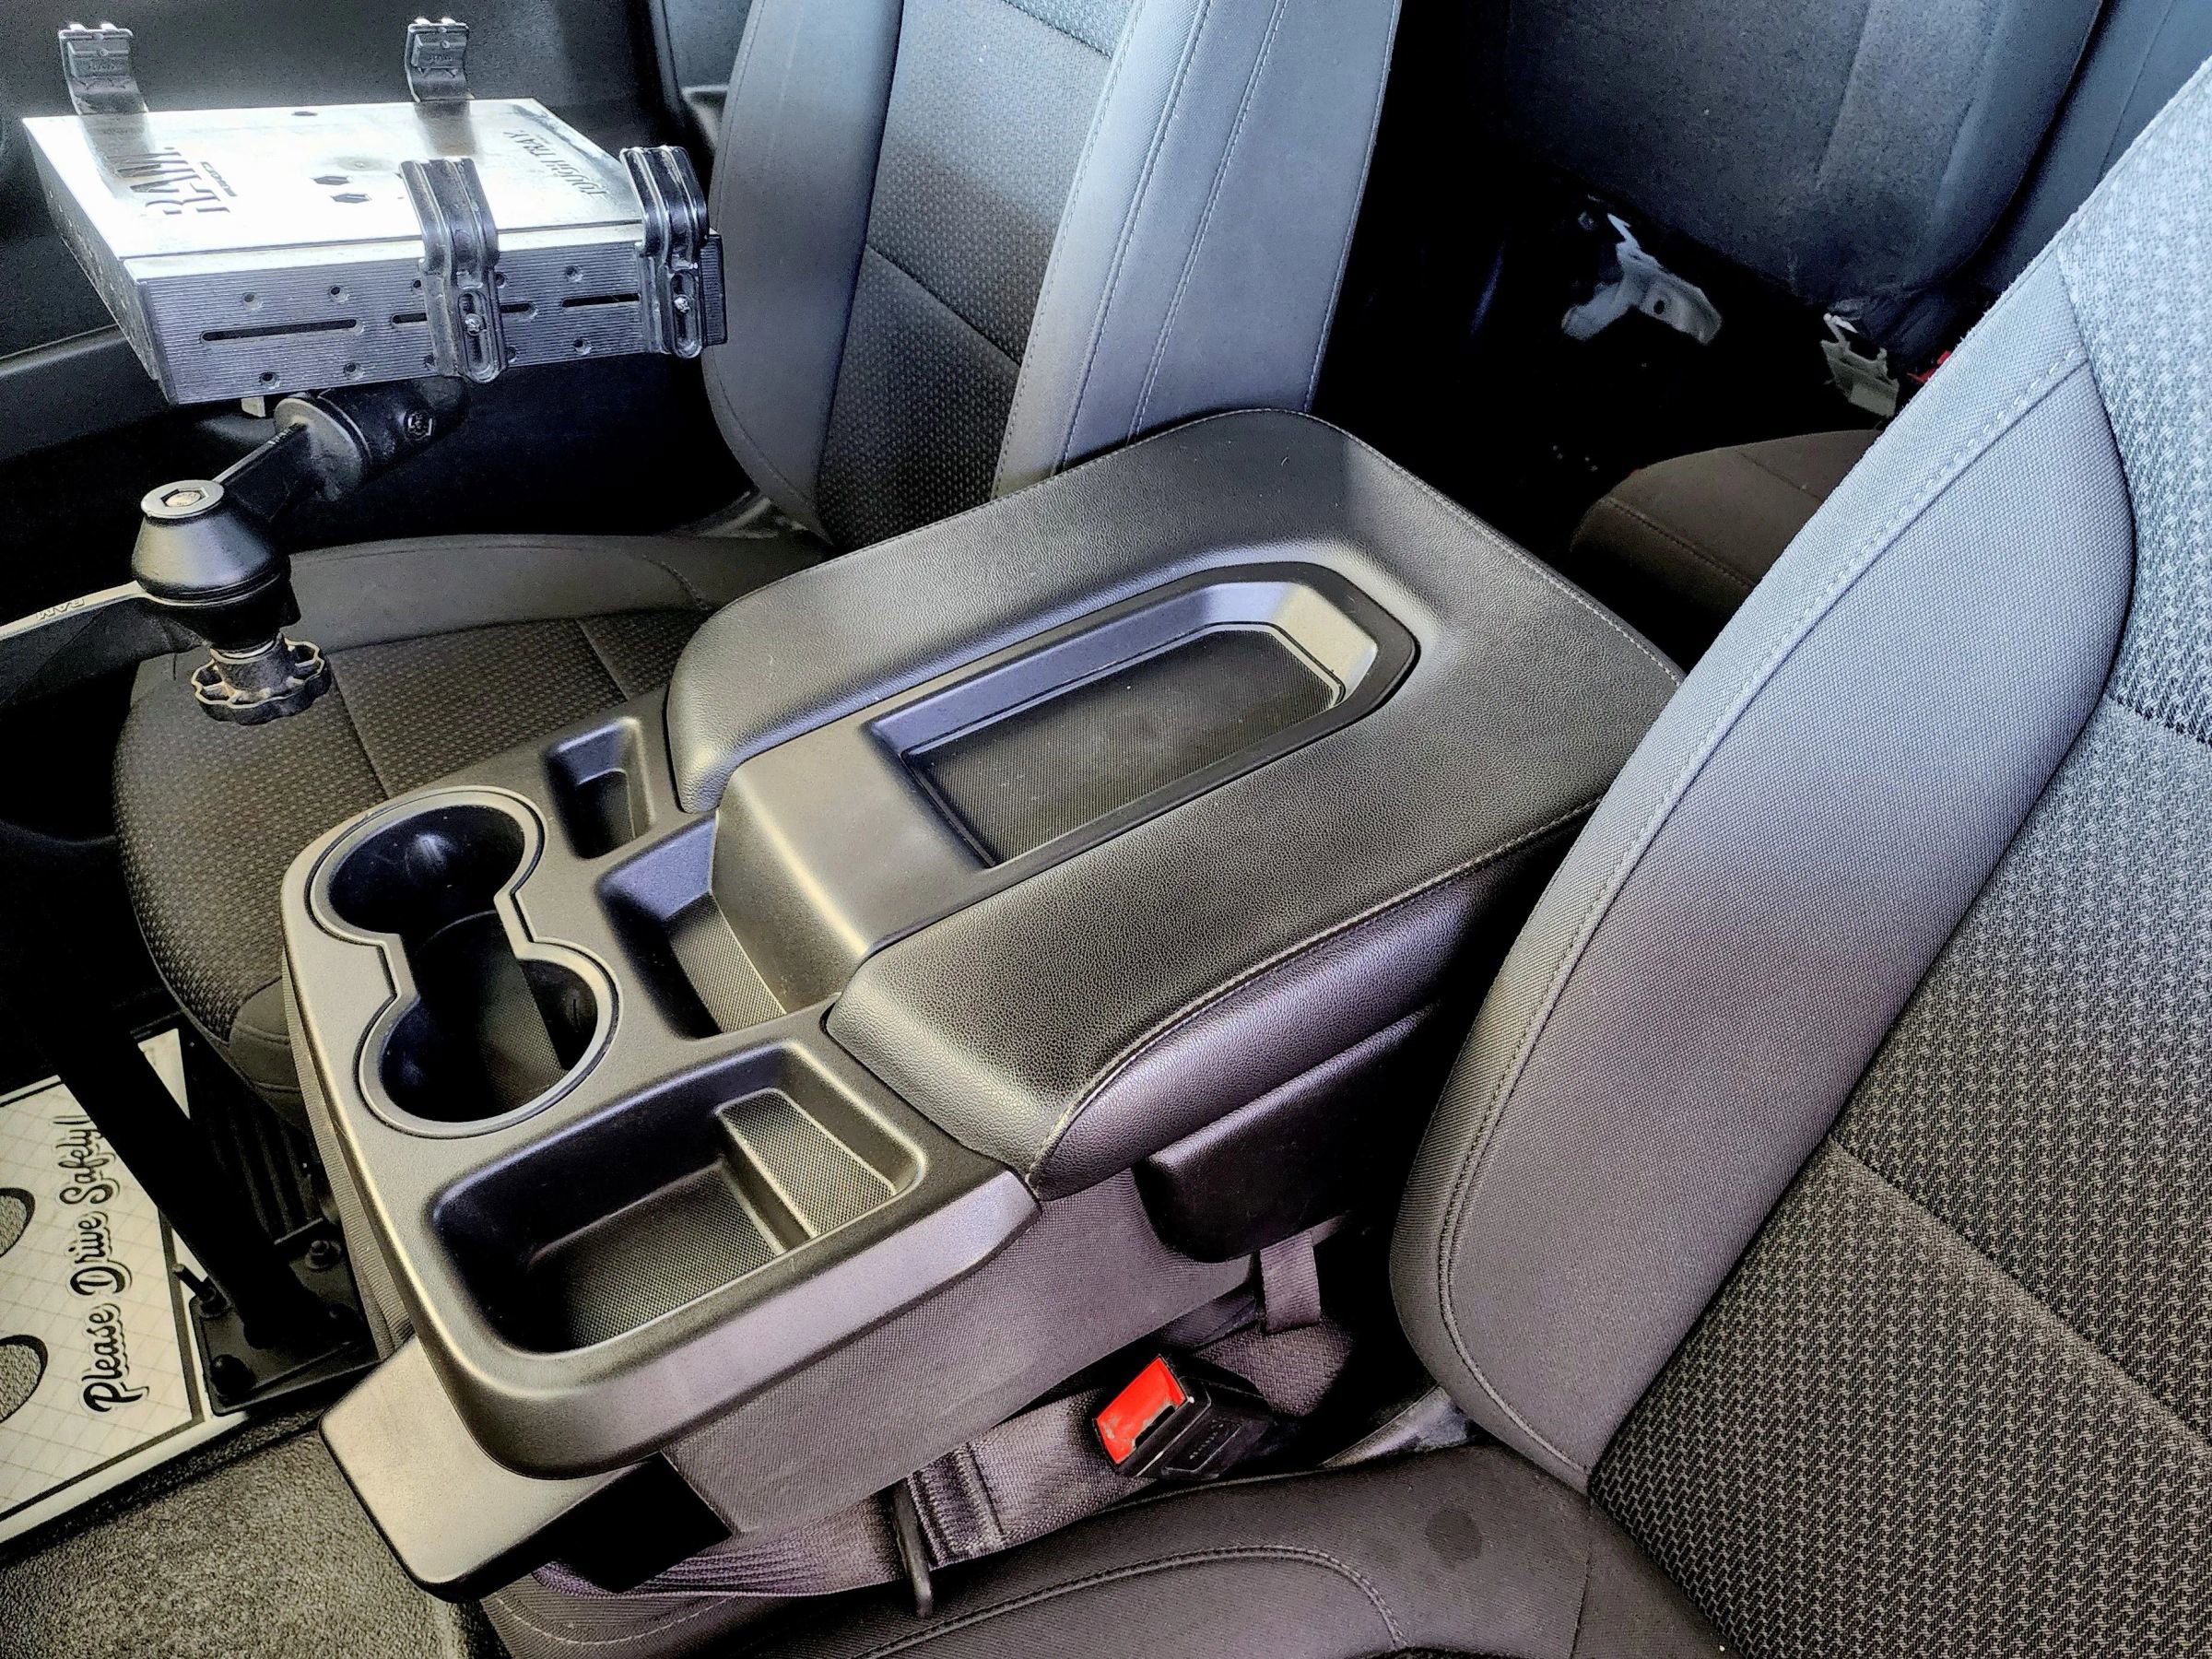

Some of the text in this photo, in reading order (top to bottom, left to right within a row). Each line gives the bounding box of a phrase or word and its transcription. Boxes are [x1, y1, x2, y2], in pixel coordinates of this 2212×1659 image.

[540, 159, 609, 195] TOUGH
[37, 597, 86, 620] RAM
[68, 1215, 126, 1297] Drive
[81, 1308, 144, 1413] Please
